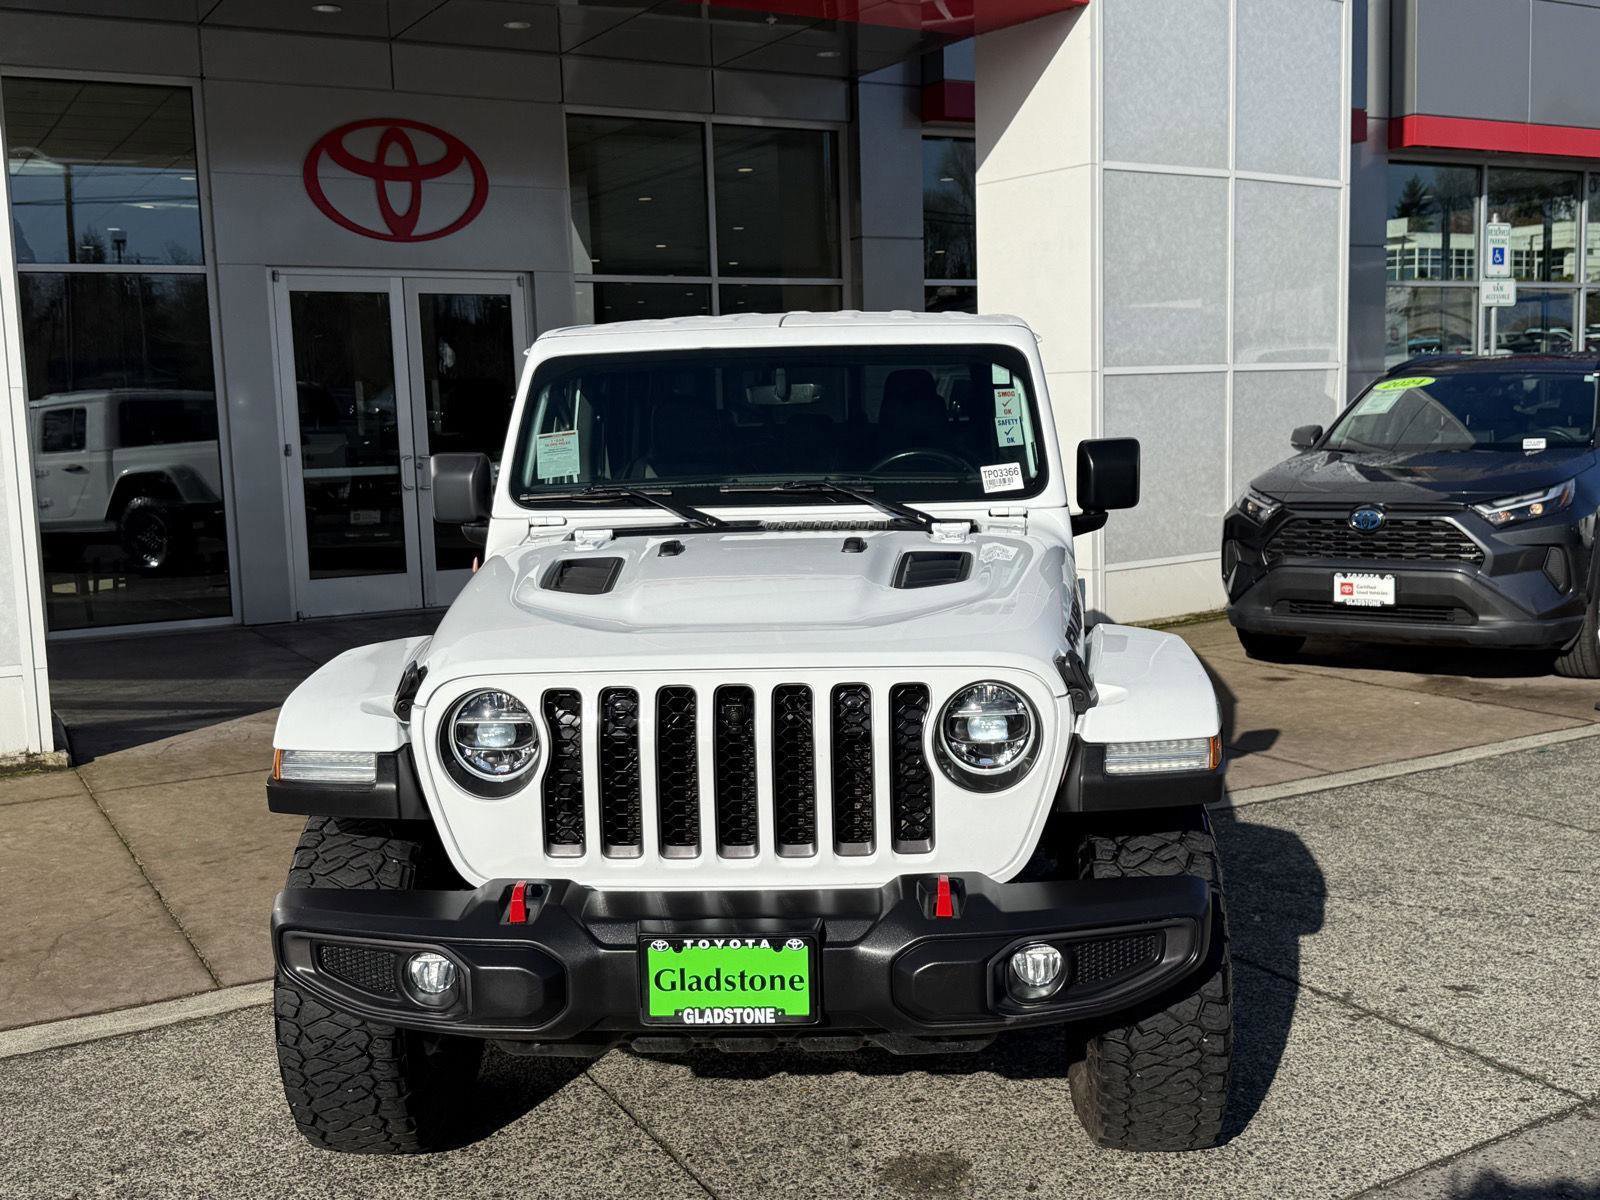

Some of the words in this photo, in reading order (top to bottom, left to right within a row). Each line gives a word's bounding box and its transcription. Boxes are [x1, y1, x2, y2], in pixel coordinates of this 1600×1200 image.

[997, 418, 1019, 426] SAFETY
[982, 466, 1020, 479] TP03366
[683, 939, 771, 950] TOYOTA
[653, 967, 805, 992] Gladstone
[682, 1008, 776, 1025] GLADSTONE
